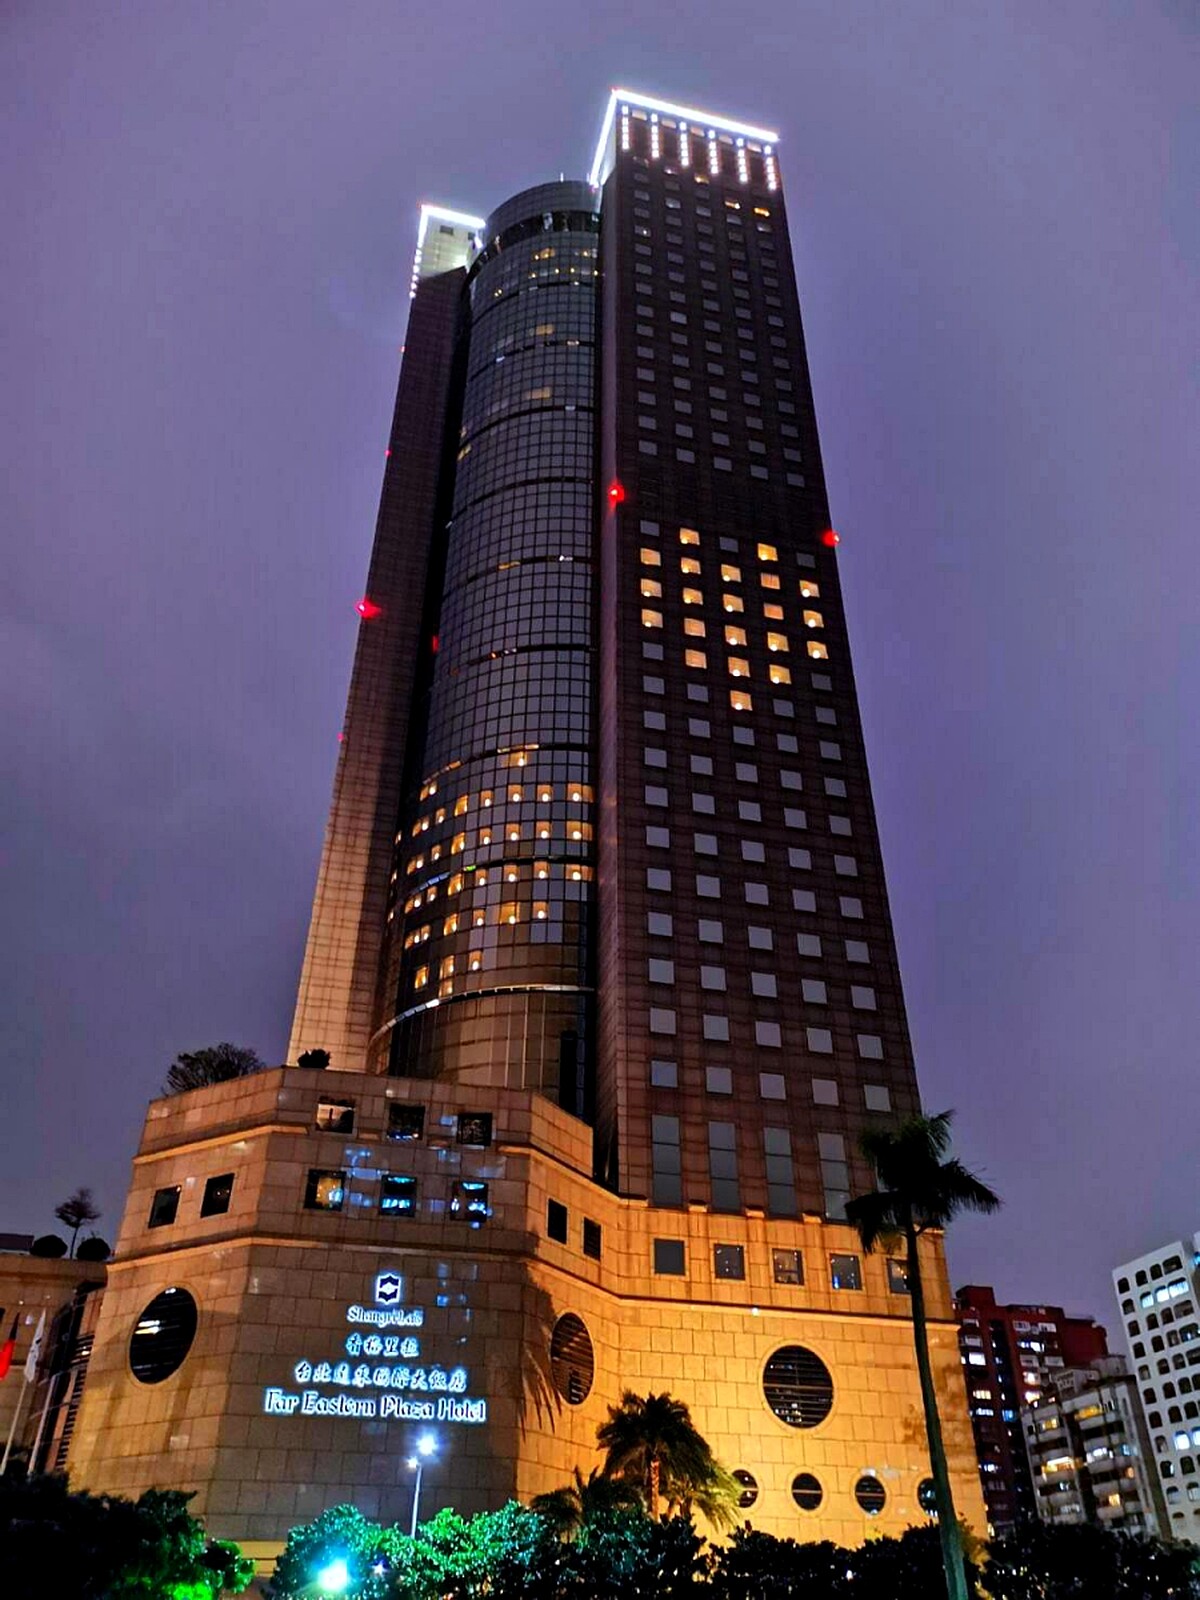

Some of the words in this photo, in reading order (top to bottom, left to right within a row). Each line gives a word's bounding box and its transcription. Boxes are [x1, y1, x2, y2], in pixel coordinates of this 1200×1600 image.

[346, 1333, 420, 1358] 香格里拉
[265, 1388, 299, 1415] Far
[303, 1391, 376, 1417] Eastern
[380, 1395, 435, 1420] Plaza
[437, 1398, 487, 1422] Hotel
